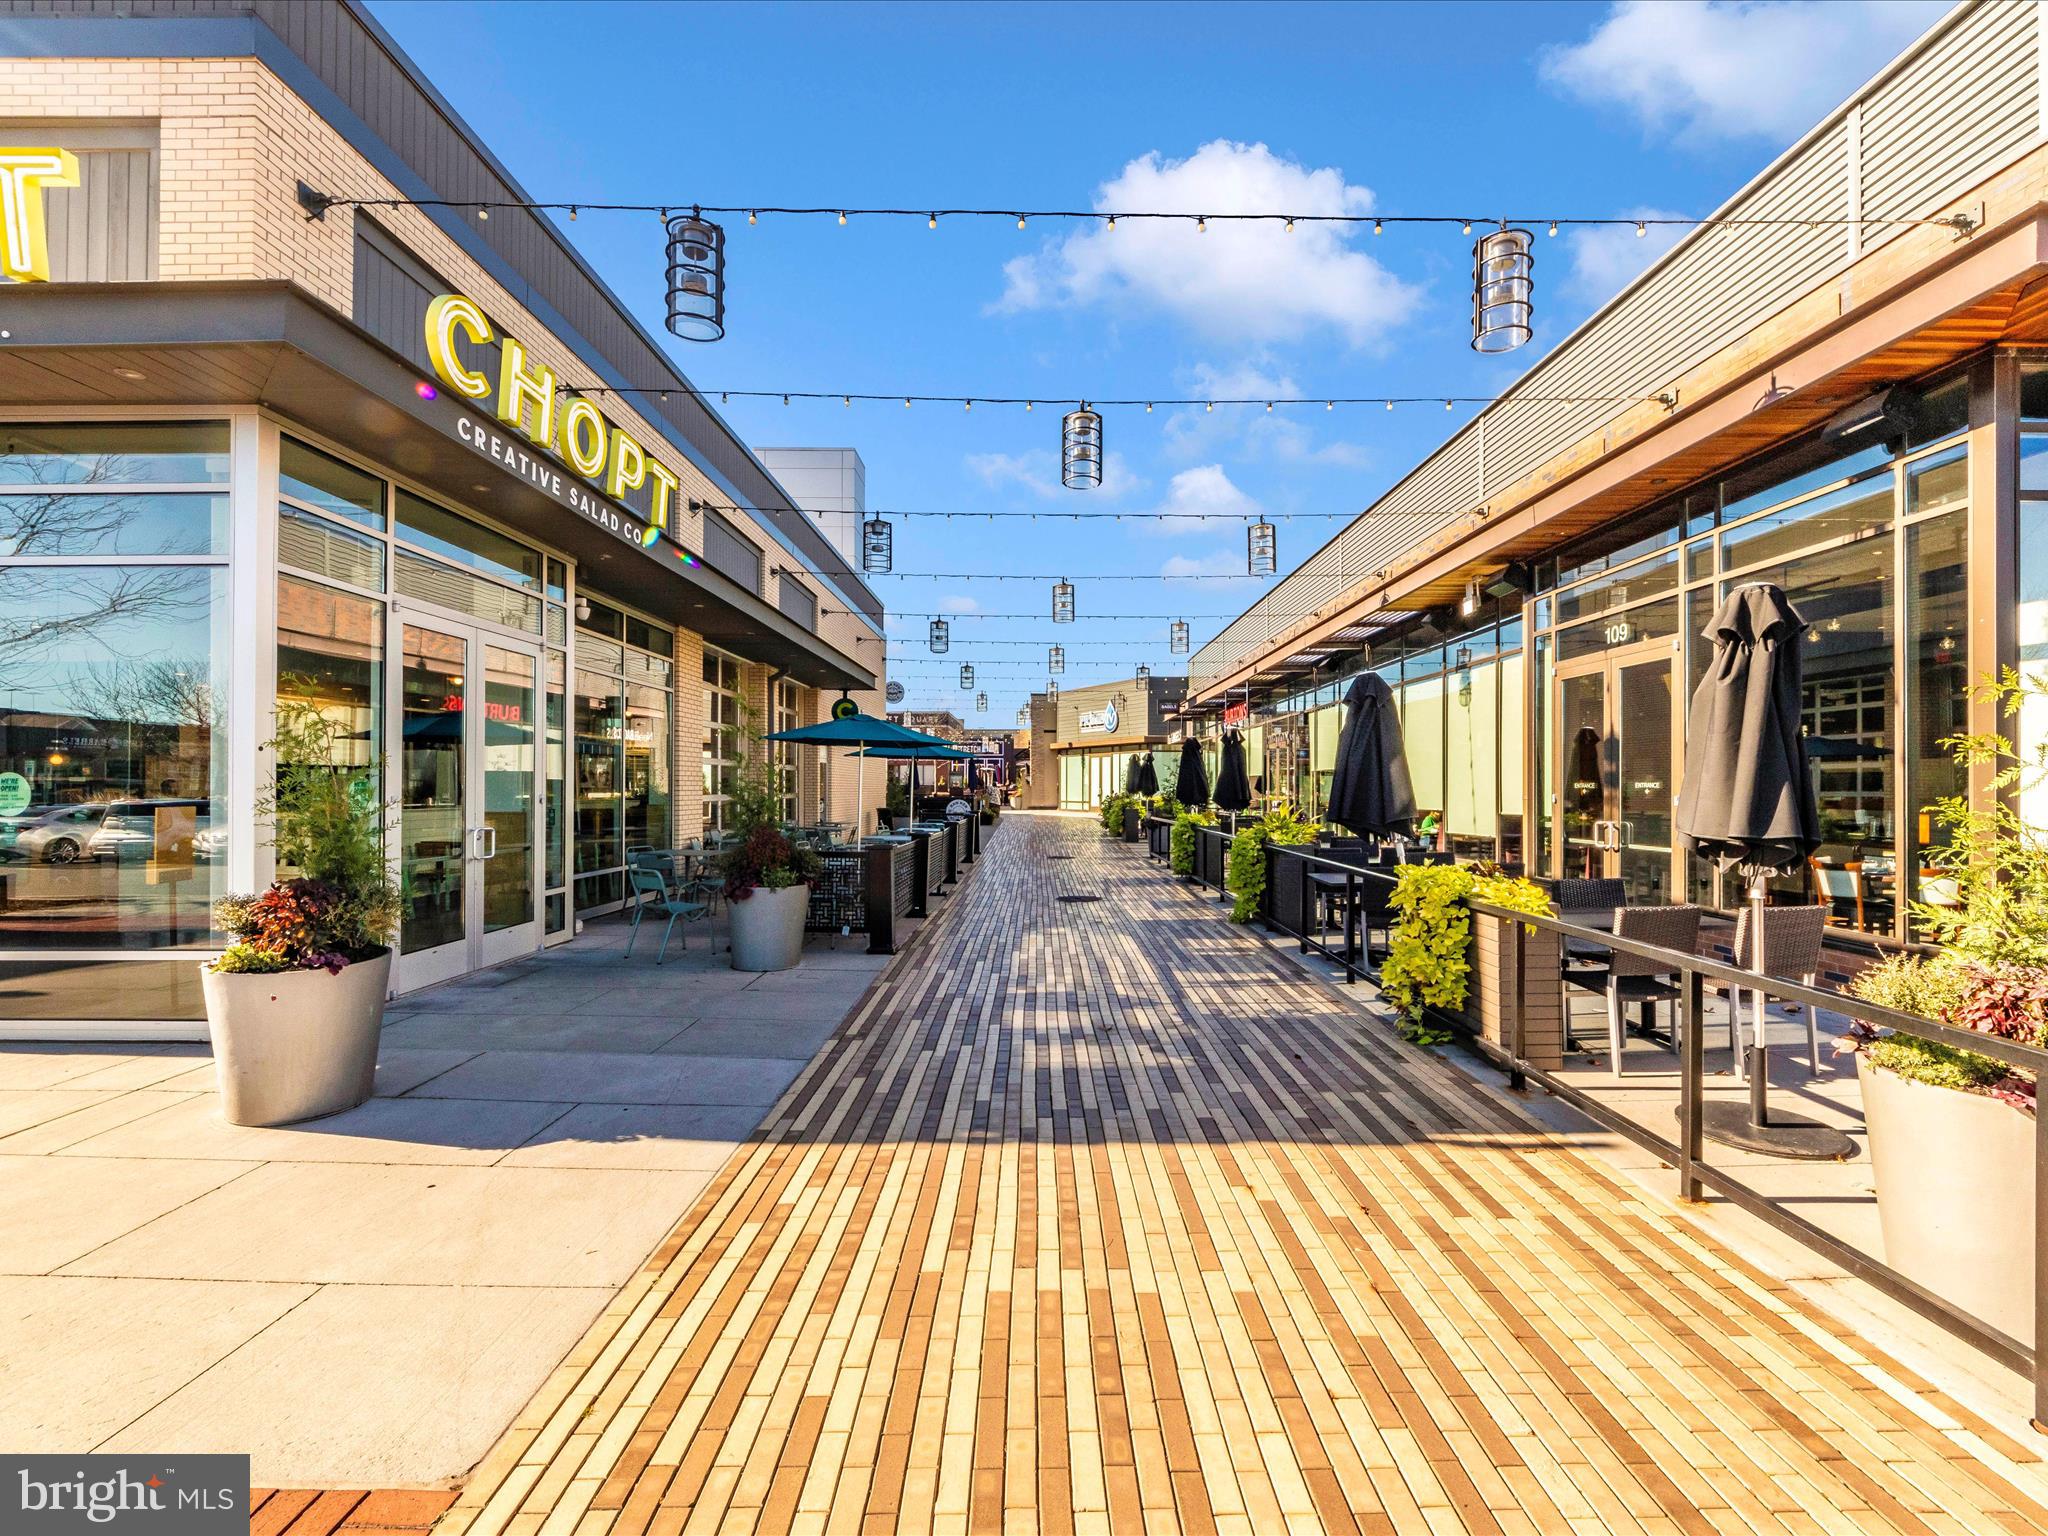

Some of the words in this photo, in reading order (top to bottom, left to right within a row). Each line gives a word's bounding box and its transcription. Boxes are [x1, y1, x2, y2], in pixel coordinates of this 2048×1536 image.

[425, 294, 679, 529] CHOPT
[457, 417, 561, 496] CREATIVE
[569, 487, 618, 531] SALAD
[1605, 623, 1628, 644] 109
